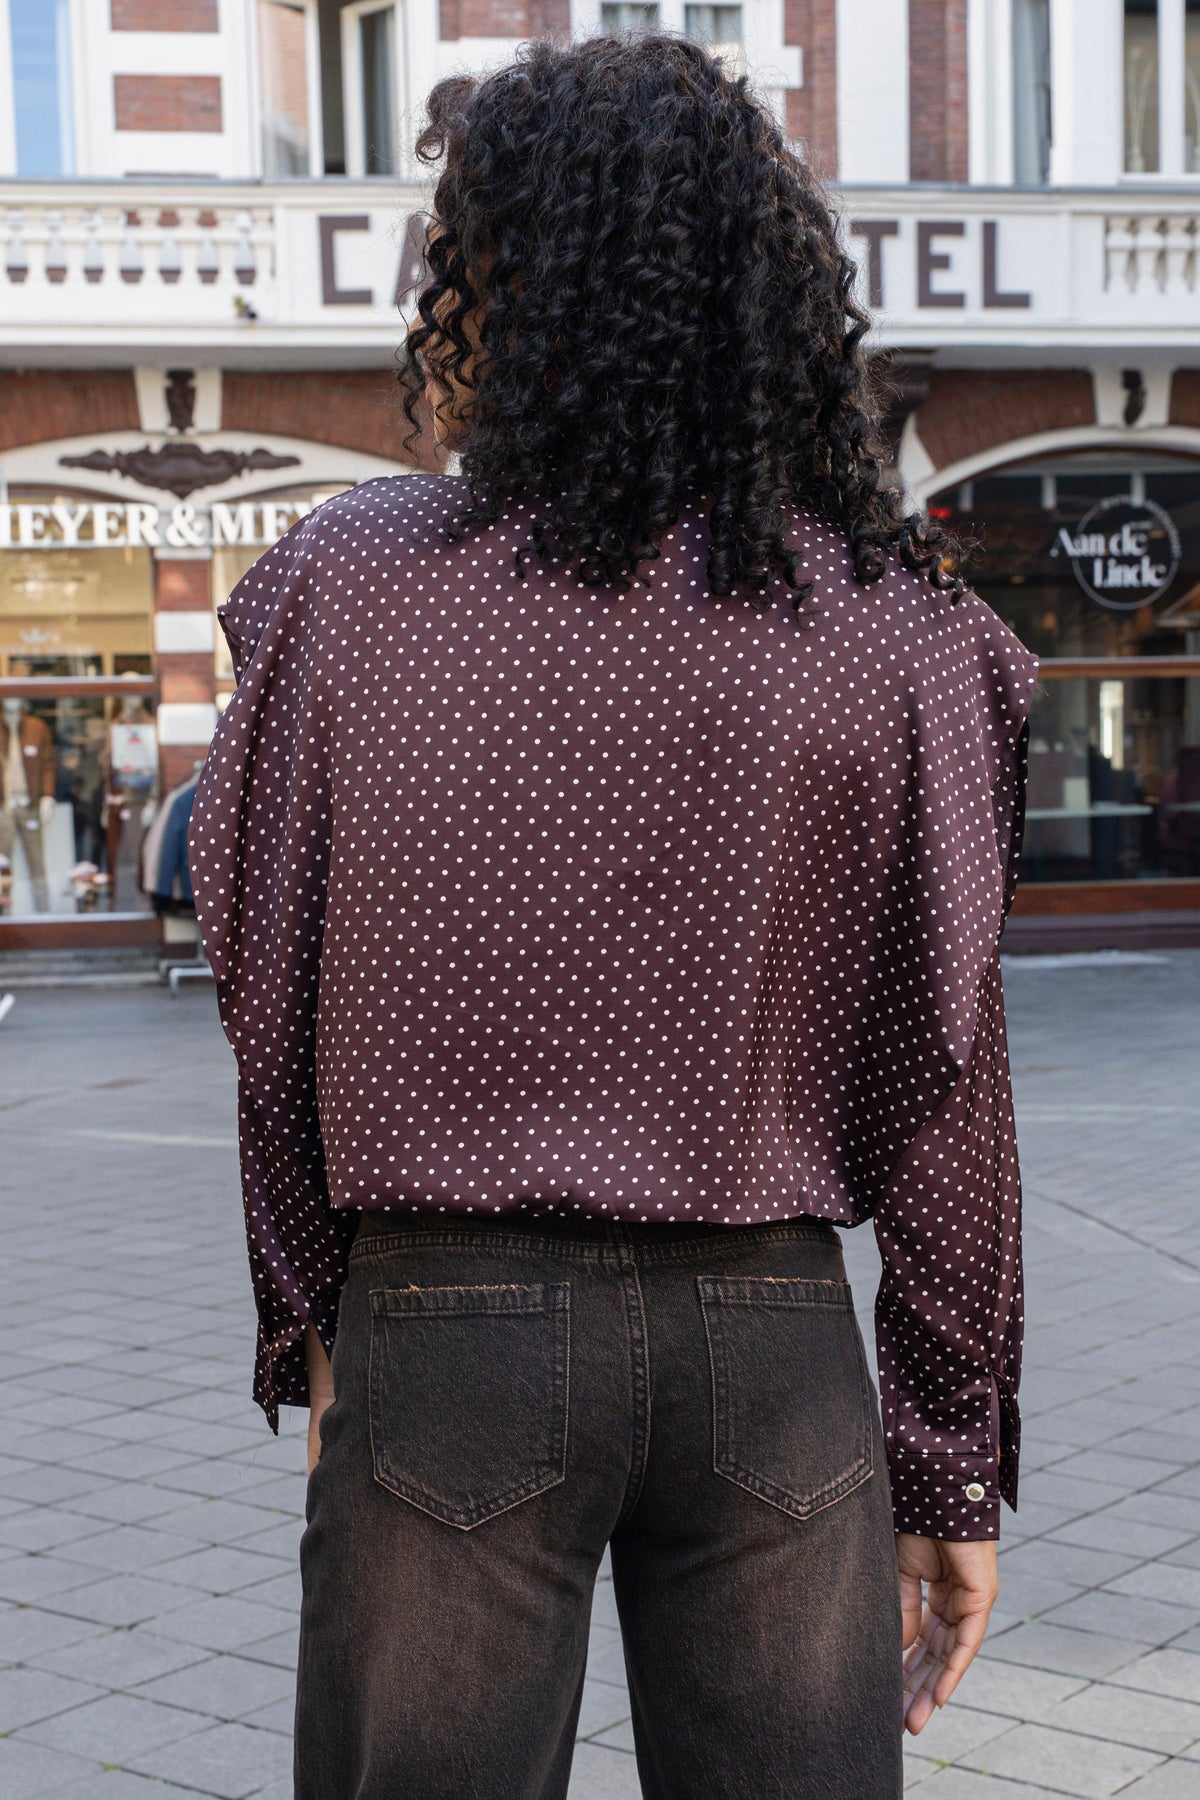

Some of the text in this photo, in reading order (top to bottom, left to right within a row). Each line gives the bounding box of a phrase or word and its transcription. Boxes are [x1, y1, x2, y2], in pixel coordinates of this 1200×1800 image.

[1050, 527, 1105, 557] Aan
[1109, 524, 1149, 556] de
[1094, 555, 1167, 588] Linde
